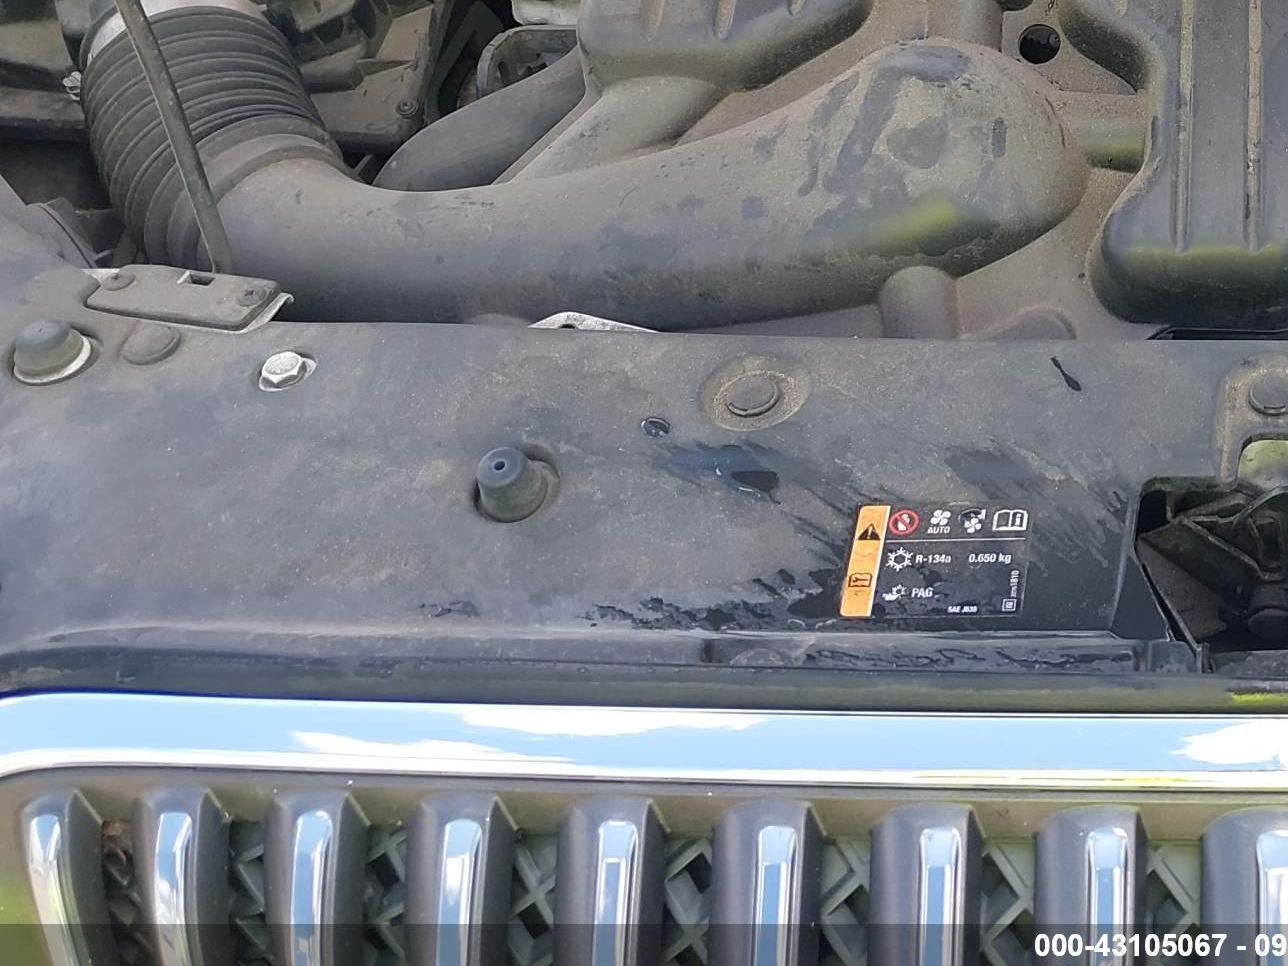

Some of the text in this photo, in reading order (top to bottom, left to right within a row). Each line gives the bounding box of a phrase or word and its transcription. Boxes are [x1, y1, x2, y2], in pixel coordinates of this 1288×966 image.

[927, 526, 951, 534] AUTO
[915, 554, 952, 564] R-134a
[968, 553, 1012, 564] 0.650 kg
[911, 587, 934, 598] PAG
